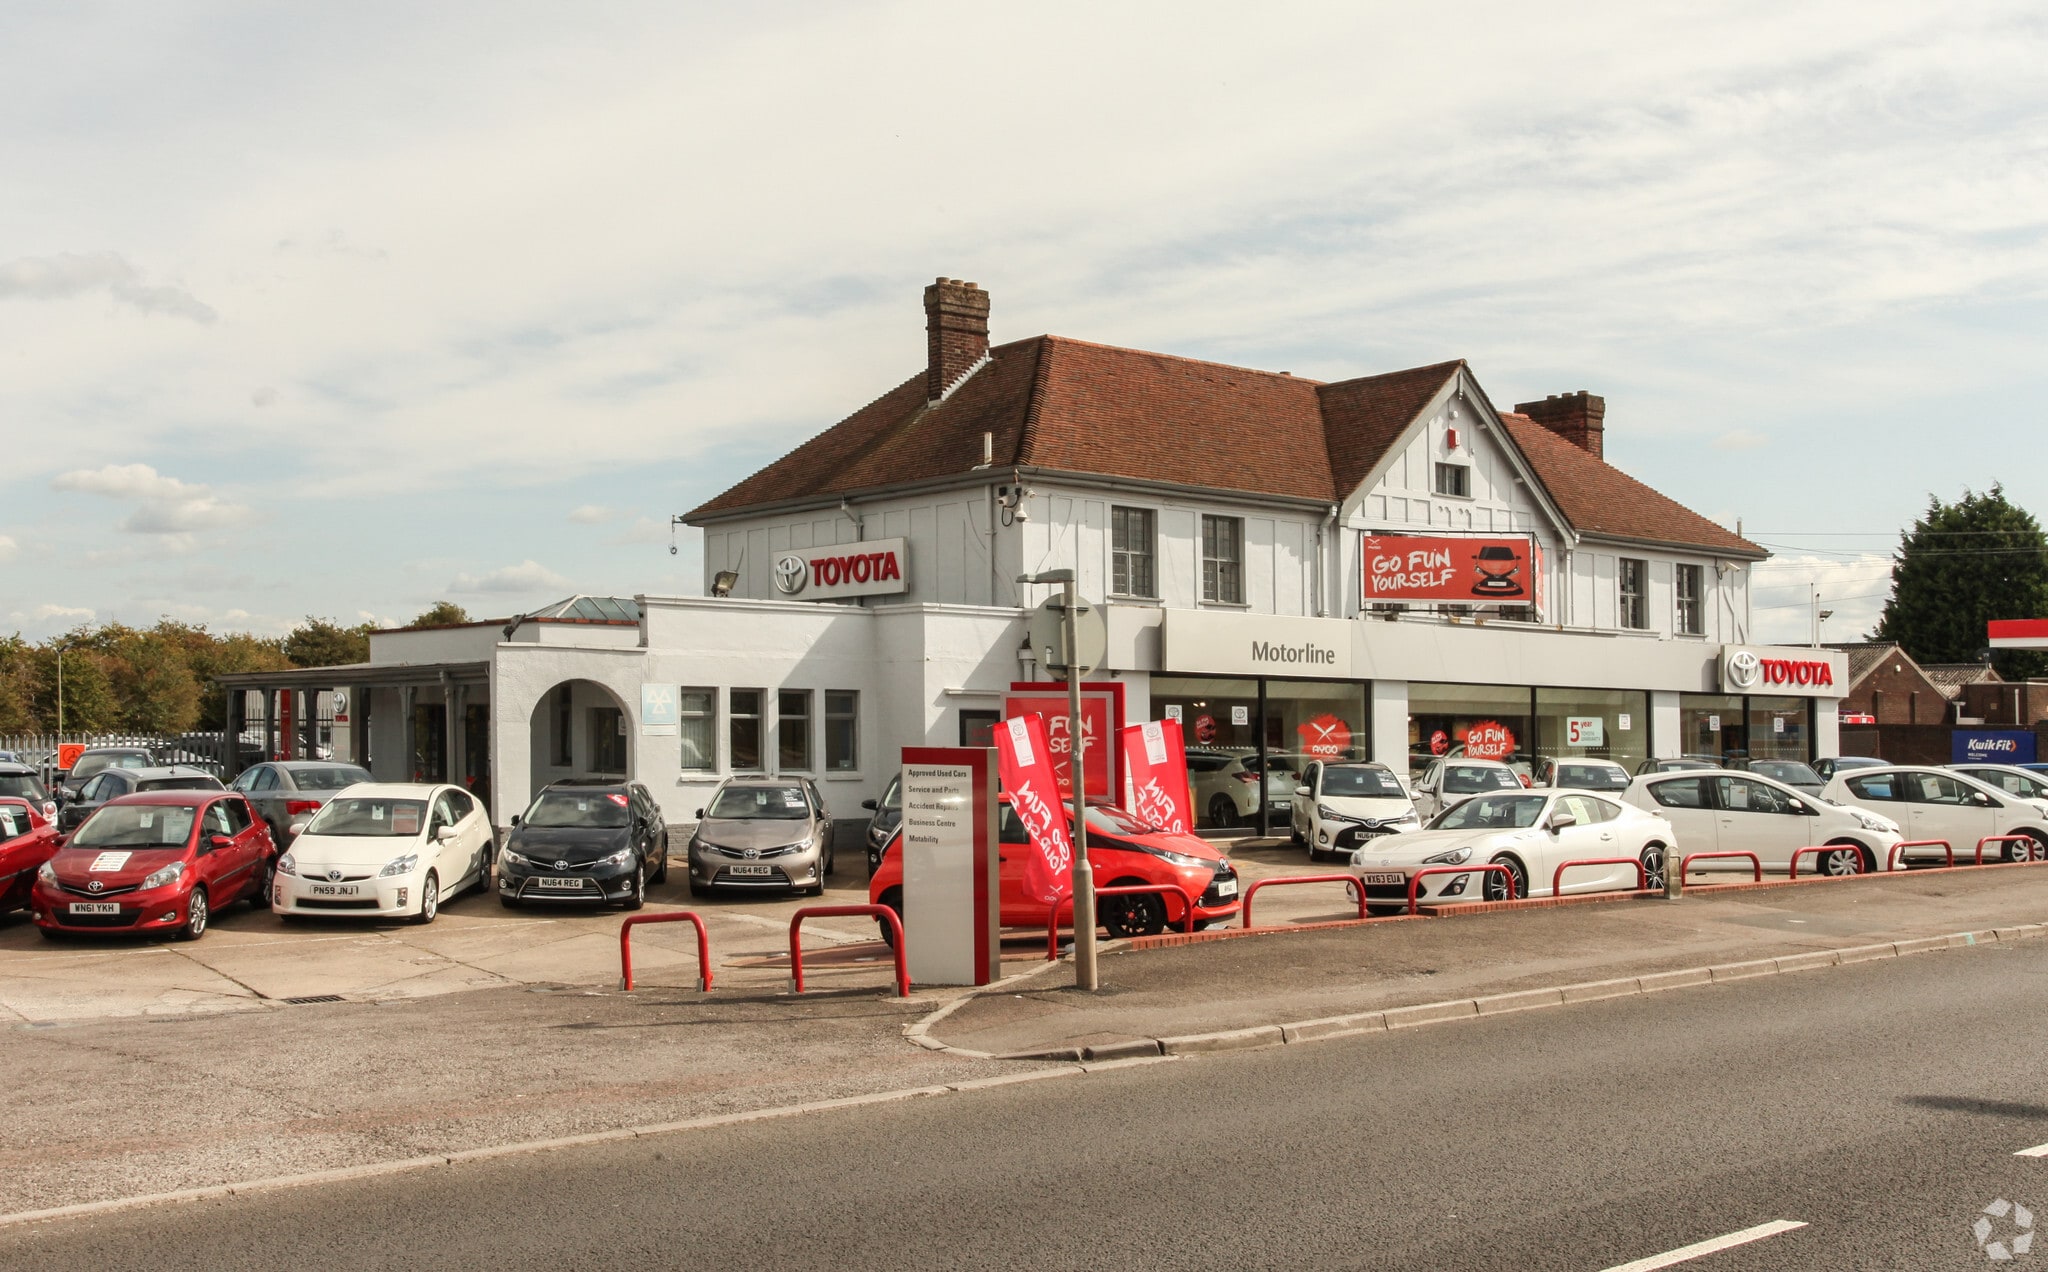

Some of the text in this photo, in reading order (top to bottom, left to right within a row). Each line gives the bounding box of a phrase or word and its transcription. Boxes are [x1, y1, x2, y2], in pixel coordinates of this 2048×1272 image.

[1372, 547, 1451, 574] GO FUN
[810, 551, 900, 586] TOYOTA
[1371, 568, 1457, 593] YOURSELF
[1252, 640, 1335, 665] Motorline
[1760, 658, 1833, 686] TOYOTA
[1468, 729, 1505, 744] GO FUN
[1570, 721, 1580, 742] 5
[1312, 744, 1338, 755] AYGO
[1467, 742, 1507, 757] YOURSELF
[908, 769, 967, 778] Approved Used Cars
[908, 785, 931, 793] Service
[932, 786, 943, 794] and
[908, 802, 935, 810] Accident
[908, 818, 956, 827] Business Centre
[908, 834, 939, 844] Motability
[732, 866, 752, 874] NU64
[541, 878, 580, 887] NU64 REG
[1366, 874, 1401, 884] WX63 EUA
[313, 886, 353, 895] PN59 JNJ
[74, 903, 114, 913] WN61 YKH
